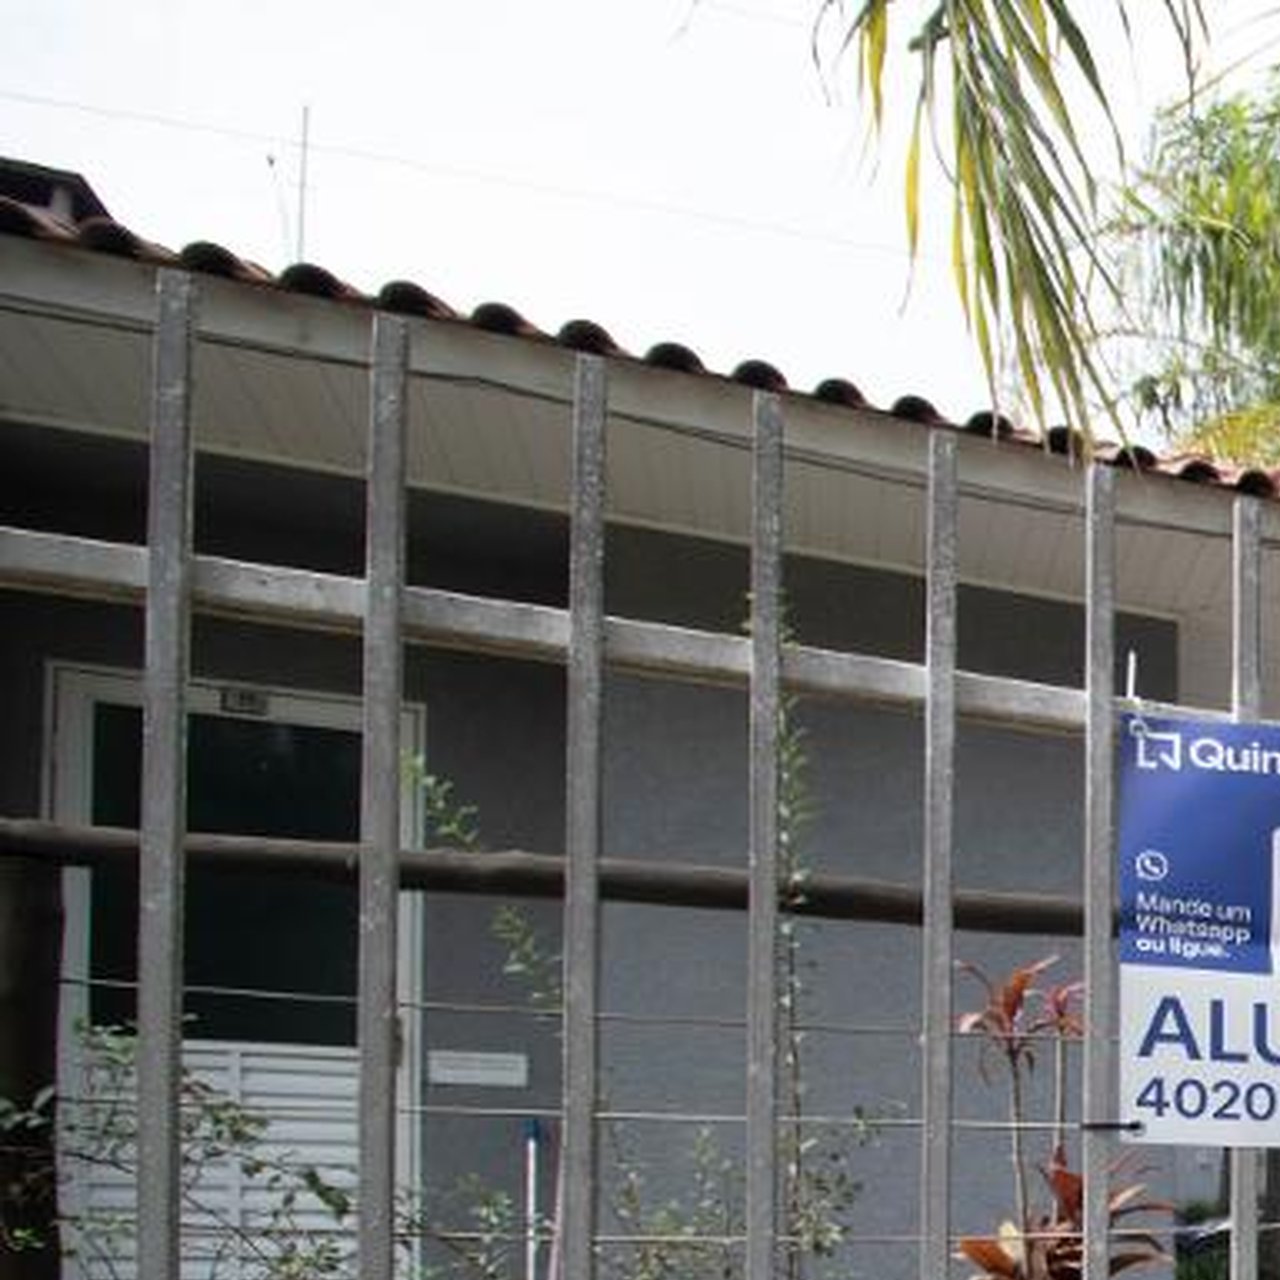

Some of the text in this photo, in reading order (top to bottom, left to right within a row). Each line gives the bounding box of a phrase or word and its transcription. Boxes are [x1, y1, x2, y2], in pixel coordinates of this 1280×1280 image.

[1137, 891, 1251, 922] Mande um
[1136, 938, 1165, 952] ou
